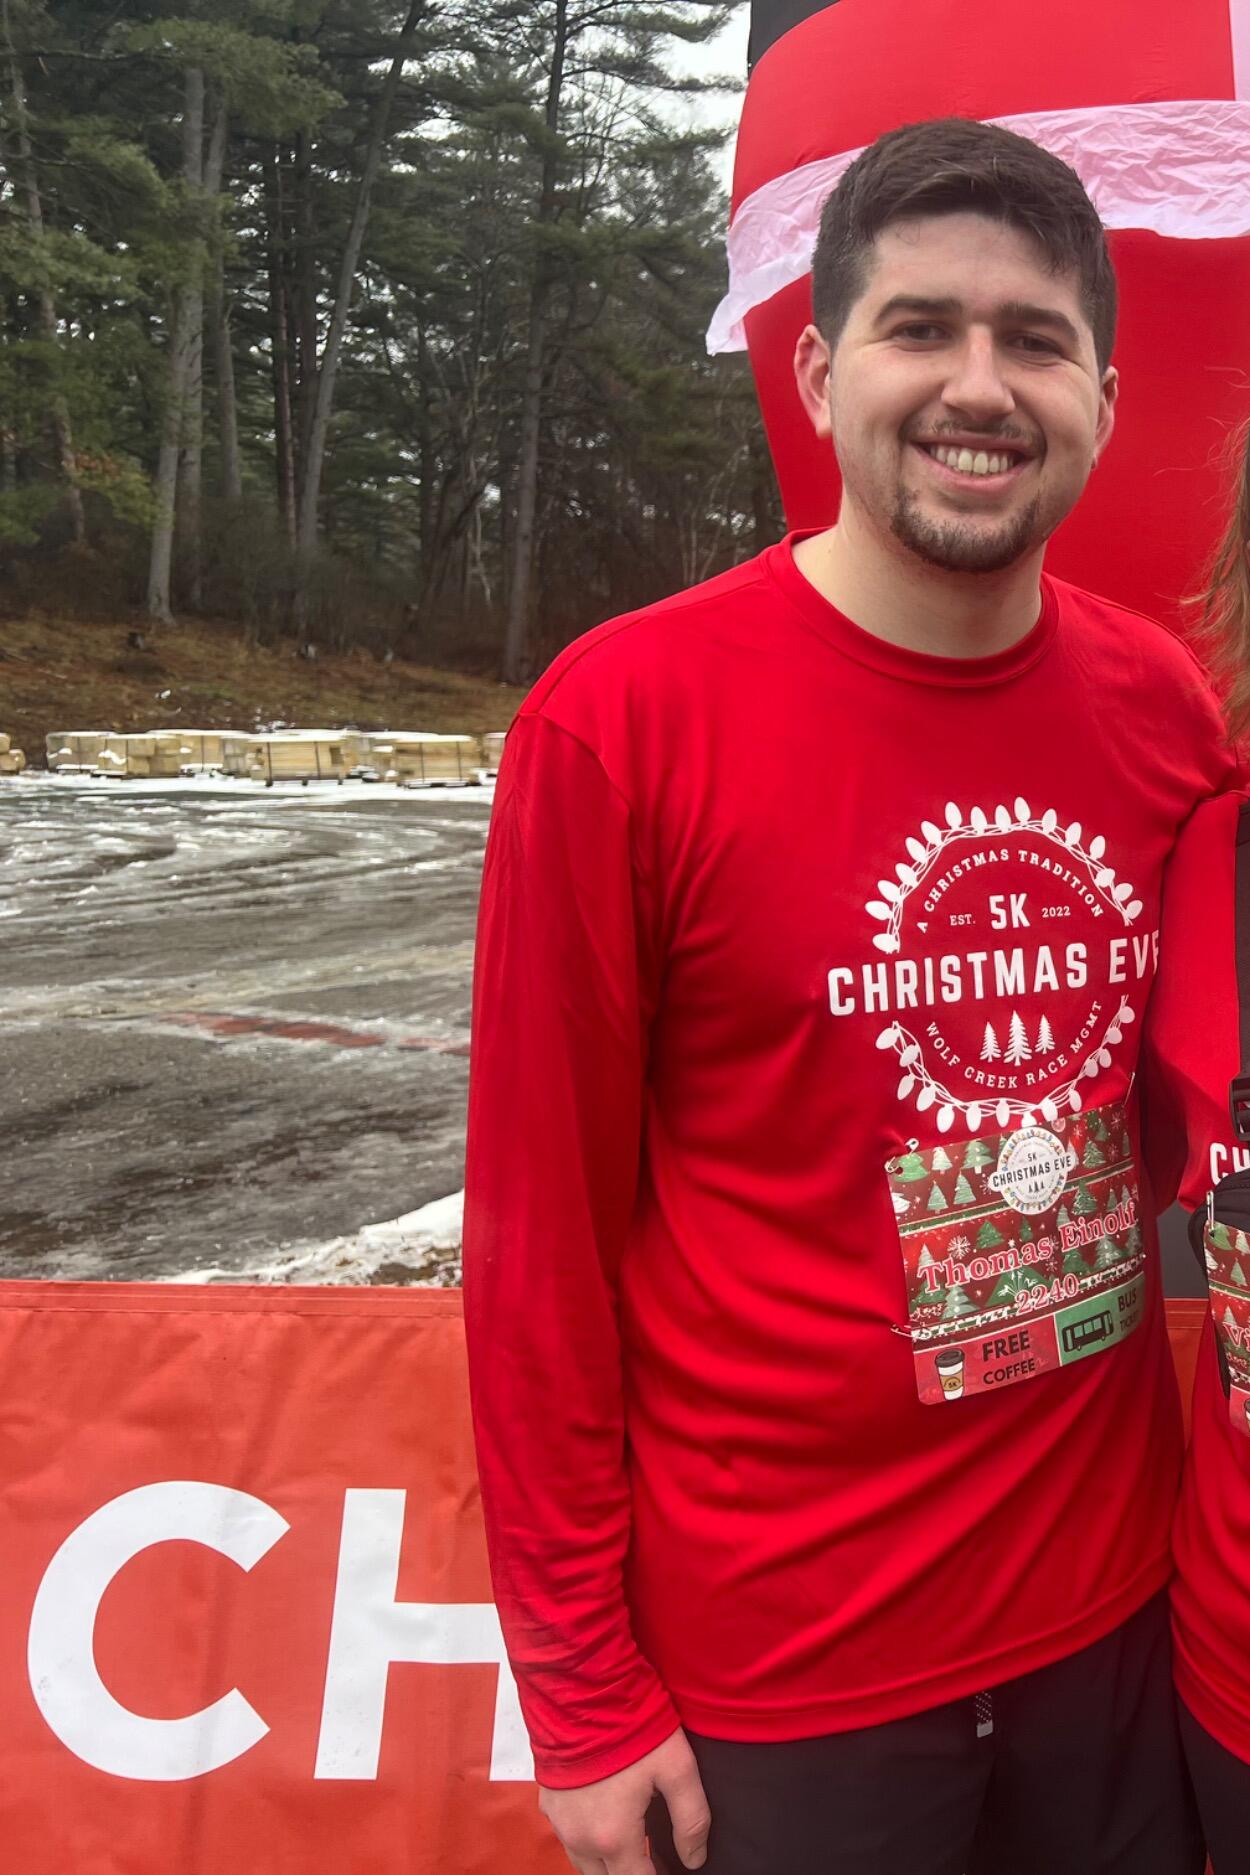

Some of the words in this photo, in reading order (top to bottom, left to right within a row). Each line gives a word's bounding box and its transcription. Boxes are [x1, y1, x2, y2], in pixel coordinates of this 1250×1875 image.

[917, 920, 929, 933] A
[924, 849, 1009, 912] CHRISTMAS
[1018, 850, 1103, 917] TRADITION
[950, 913, 976, 926] EST.
[989, 893, 1030, 929] 5K
[1042, 905, 1071, 918] 2022
[827, 943, 1087, 1016] CHRISTMAS
[926, 1021, 960, 1066] WOLF
[964, 1066, 1018, 1089] CREEK
[1026, 1053, 1068, 1086] RACE
[1070, 1000, 1101, 1053] MGMT
[992, 1161, 1050, 1187] CHRISTMAS
[1054, 1155, 1072, 1170] EVE
[1027, 1152, 1037, 1162] 5K
[917, 1235, 1053, 1293] Thomas
[1059, 1201, 1138, 1251] Einolf
[1015, 1273, 1081, 1315] 2240
[1118, 1288, 1137, 1312] BUS
[982, 1330, 1030, 1362] FREE
[983, 1358, 1035, 1384] COFFEE
